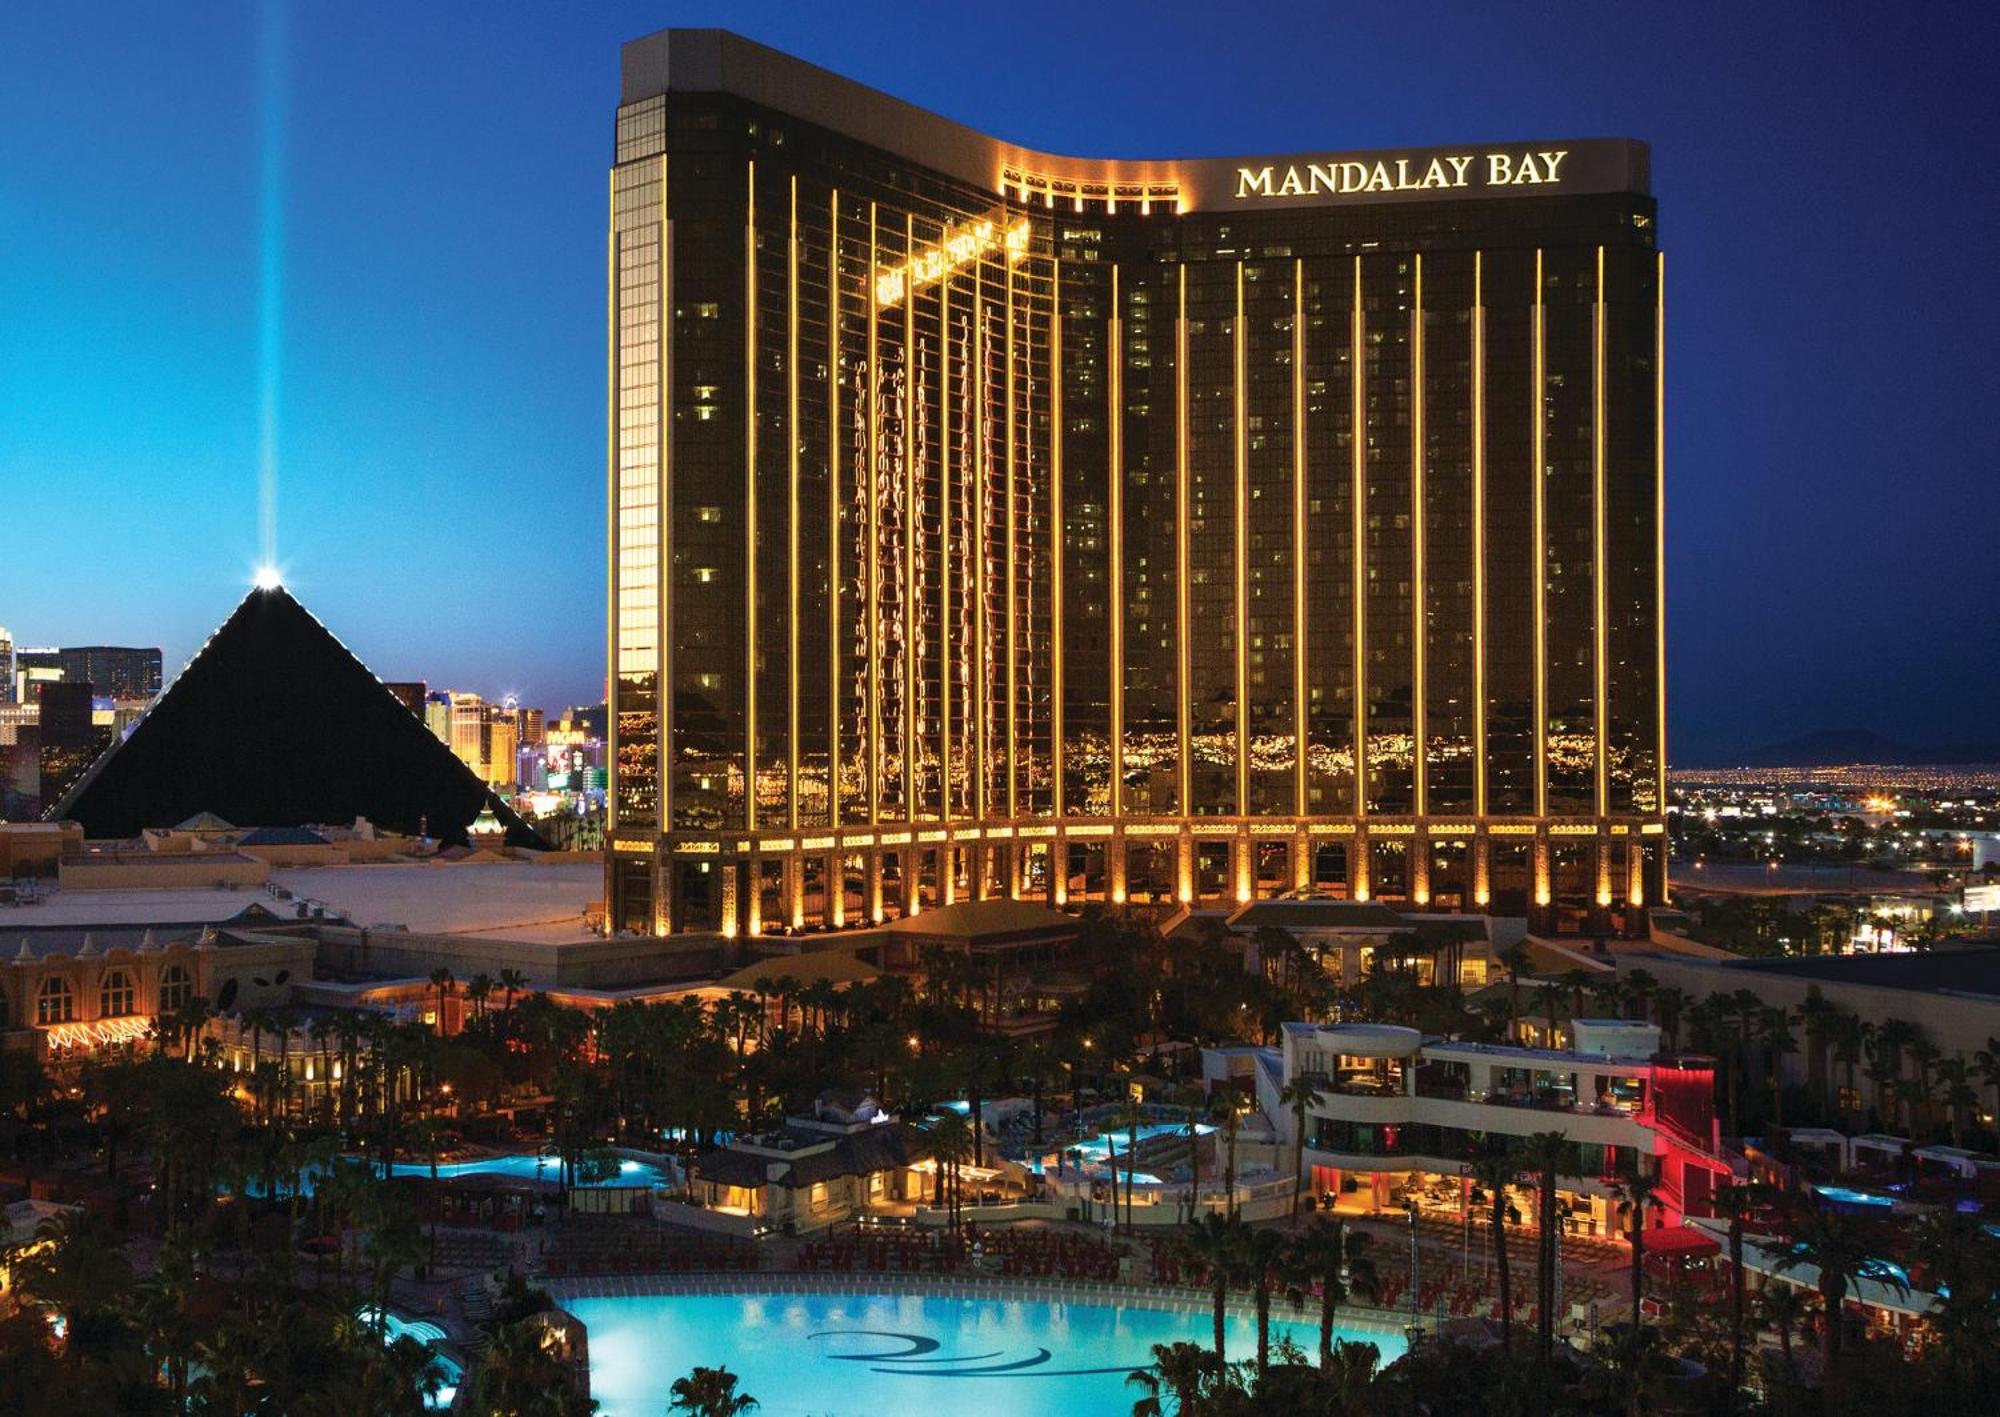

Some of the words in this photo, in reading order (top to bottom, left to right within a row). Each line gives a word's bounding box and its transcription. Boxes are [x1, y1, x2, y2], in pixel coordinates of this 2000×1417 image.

[1235, 156, 1474, 198] MANDALAY
[1487, 151, 1567, 185] BAY
[546, 731, 585, 744] MGM
